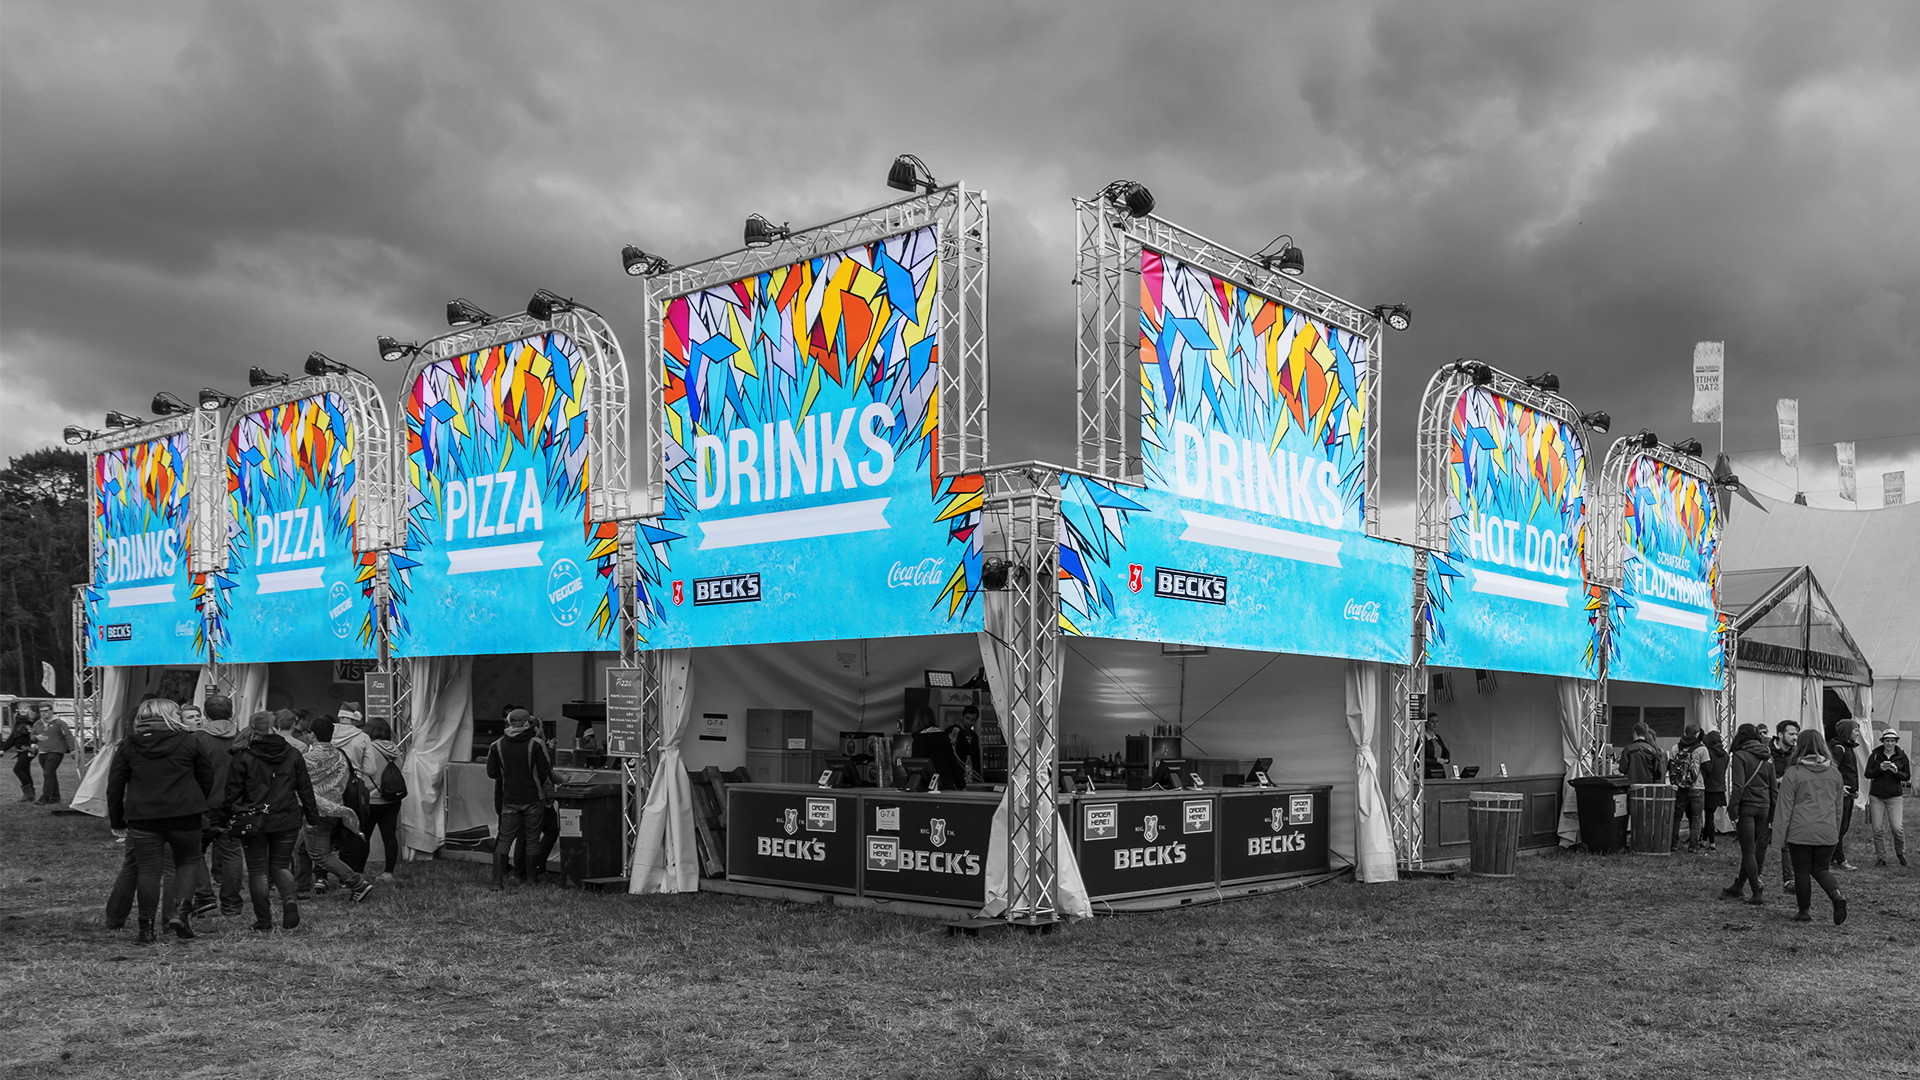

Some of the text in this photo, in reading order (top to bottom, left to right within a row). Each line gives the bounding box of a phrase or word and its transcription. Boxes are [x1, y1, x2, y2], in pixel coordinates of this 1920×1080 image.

[696, 402, 896, 510] DRINKS
[1175, 419, 1344, 530] DRINKS
[445, 467, 543, 541] PIZZA
[256, 505, 325, 566] PIZZA
[1468, 510, 1571, 579] HOT DOG
[107, 528, 178, 583] DRINKS
[887, 557, 946, 589] Coca-Cola
[1158, 572, 1225, 600] BECK'S
[1634, 562, 1709, 609] FLADENBROT
[548, 576, 584, 605] VEGGIE
[696, 574, 759, 601] BECK'S
[108, 624, 131, 638] BECK'S
[335, 665, 378, 679] VIST
[706, 719, 724, 727] G-7.4
[811, 804, 831, 812] ORDER
[811, 811, 829, 819] HERE!
[880, 810, 896, 818] G-7.4
[1090, 811, 1111, 819] ORDER
[1188, 806, 1207, 814] ORDER
[1188, 813, 1206, 821] HERE!
[1090, 818, 1110, 826] HERE!
[757, 836, 826, 862] BECK'S
[872, 850, 892, 858] HERE!
[1114, 840, 1187, 870] BECK'S
[1248, 830, 1306, 856] BECK'S
[899, 848, 981, 876] BECK'S
